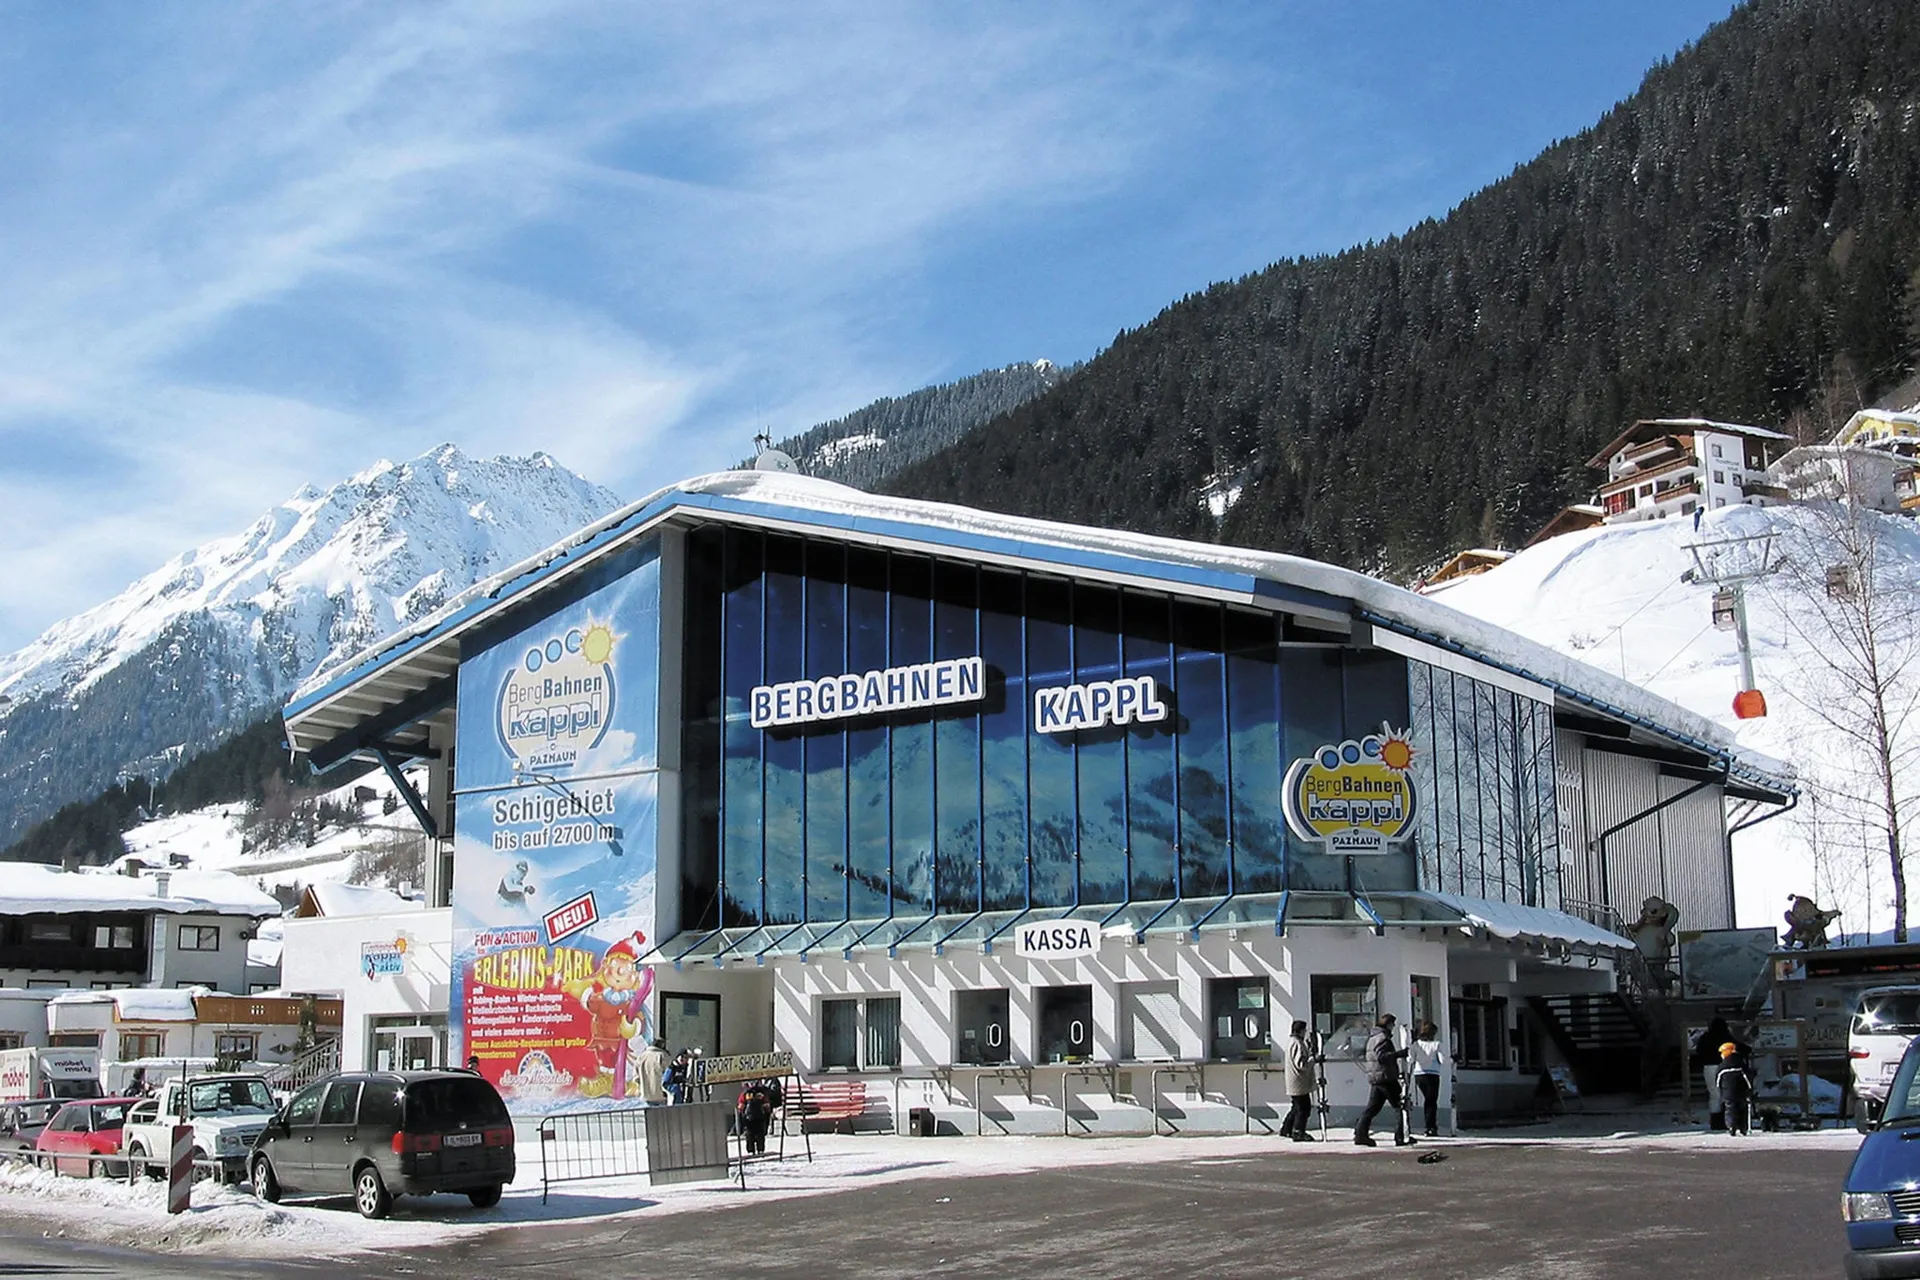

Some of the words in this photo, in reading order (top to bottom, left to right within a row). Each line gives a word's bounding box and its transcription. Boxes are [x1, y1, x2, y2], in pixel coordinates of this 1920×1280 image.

[508, 675, 602, 705] BergBahnen
[752, 659, 982, 725] BERGBAHNEN
[1037, 677, 1163, 730] KAPPL
[508, 691, 602, 741] kappl
[529, 750, 578, 766] PAZNAUN
[1305, 775, 1403, 796] BergBahnen
[495, 788, 614, 824] Schigebiet
[1307, 792, 1404, 827] kappl
[494, 831, 517, 850] bis
[523, 827, 549, 848] auf
[554, 824, 593, 845] 2700
[599, 826, 613, 840] m
[1332, 836, 1381, 846] PAZNAUN
[552, 902, 589, 934] NEU!
[474, 934, 494, 946] FUN
[494, 935, 502, 945] &
[503, 931, 538, 945] ACTION
[1024, 927, 1092, 951] KASSA
[473, 946, 594, 989] ERLEBNIS-PARK
[762, 1051, 793, 1069] LADNER
